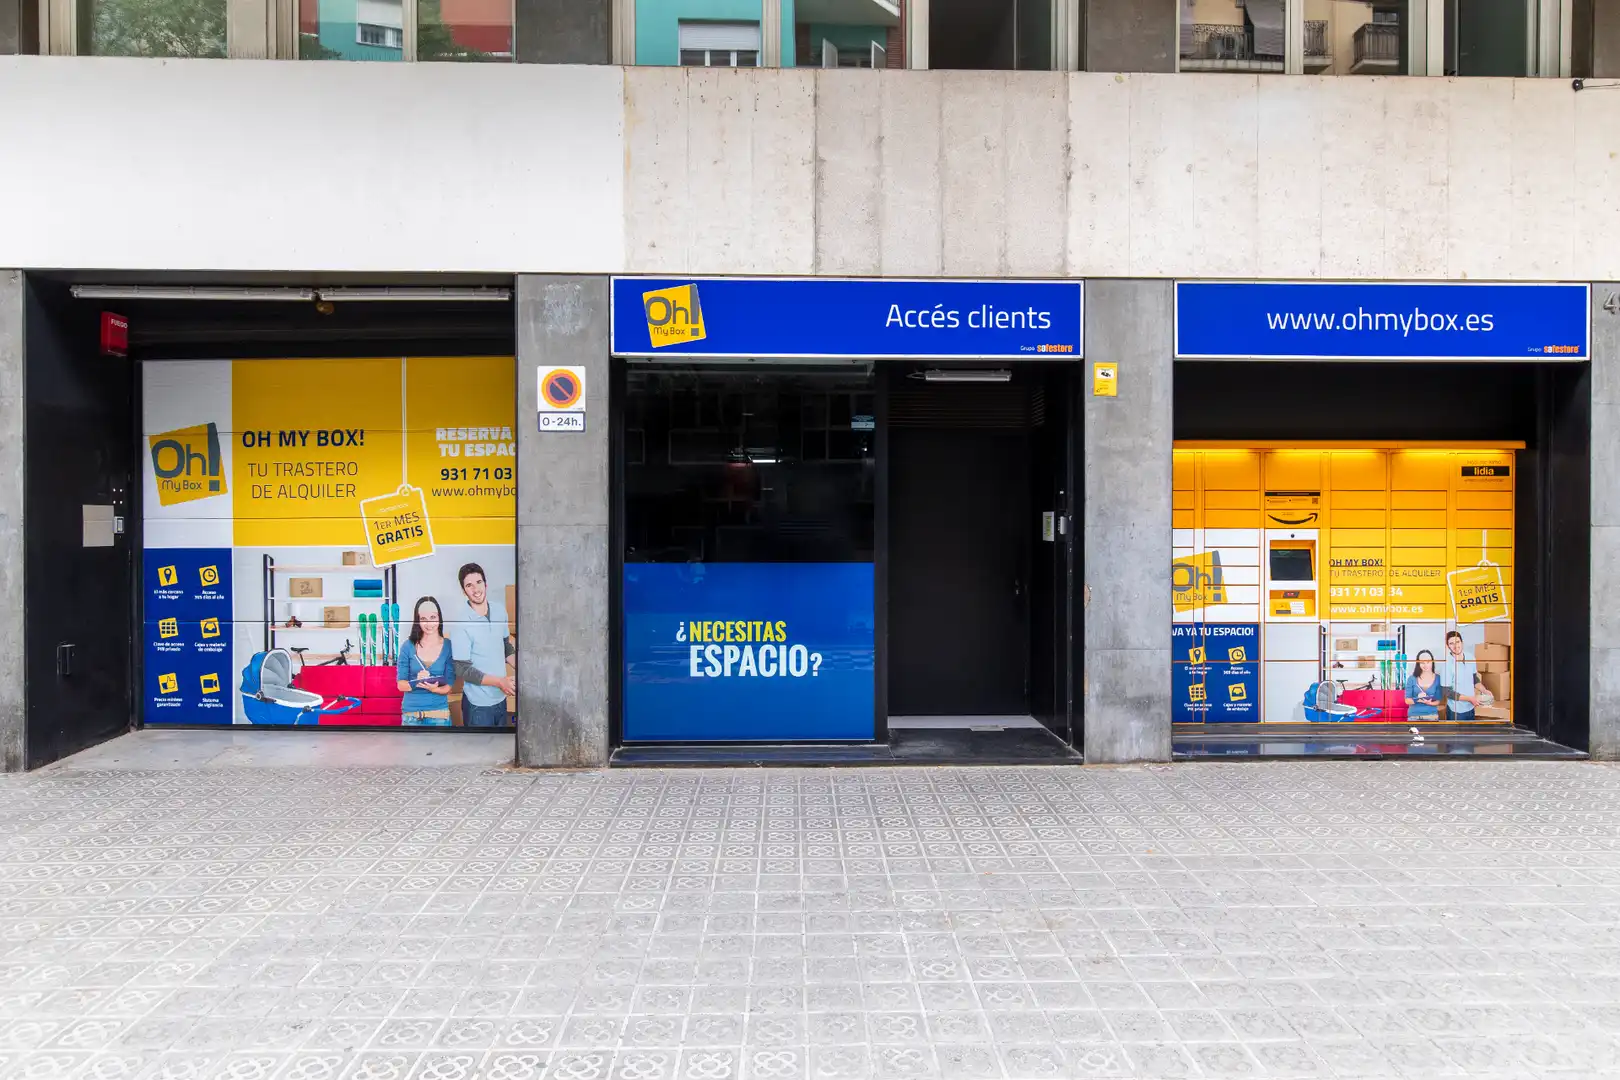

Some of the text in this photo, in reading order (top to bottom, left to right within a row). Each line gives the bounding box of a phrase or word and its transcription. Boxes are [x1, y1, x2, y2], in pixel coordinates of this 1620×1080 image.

[645, 283, 700, 337] Oh!
[1603, 291, 1620, 315] 4
[111, 318, 128, 329] FUEGO
[885, 303, 1051, 329] Accés clients
[1267, 307, 1494, 337] www.ohmybox.es
[653, 326, 685, 337] My Box
[1544, 345, 1578, 353] safestore
[242, 429, 365, 448] OH MY BOX!
[436, 426, 512, 441] RESERVA
[151, 422, 220, 491] Oh!
[439, 443, 460, 457] TU
[248, 461, 358, 477] TU TRASTERO
[440, 467, 512, 480] 931 71 03
[1474, 466, 1495, 476] lidia
[161, 479, 202, 492] My Box
[251, 483, 356, 500] DE ALQUILER
[394, 511, 420, 526] MES
[376, 525, 424, 545] GRATIS
[1172, 550, 1222, 602] Oh!
[1330, 587, 1403, 597] 931 71 03 34
[1475, 581, 1496, 594] MES
[1460, 592, 1499, 609] GRATIS
[676, 620, 787, 642] ¿NECESITAS
[1185, 627, 1198, 636] YA
[1199, 627, 1212, 636] TU
[1213, 627, 1254, 636] ESPACIO!
[690, 644, 823, 677] ESPACIO?
